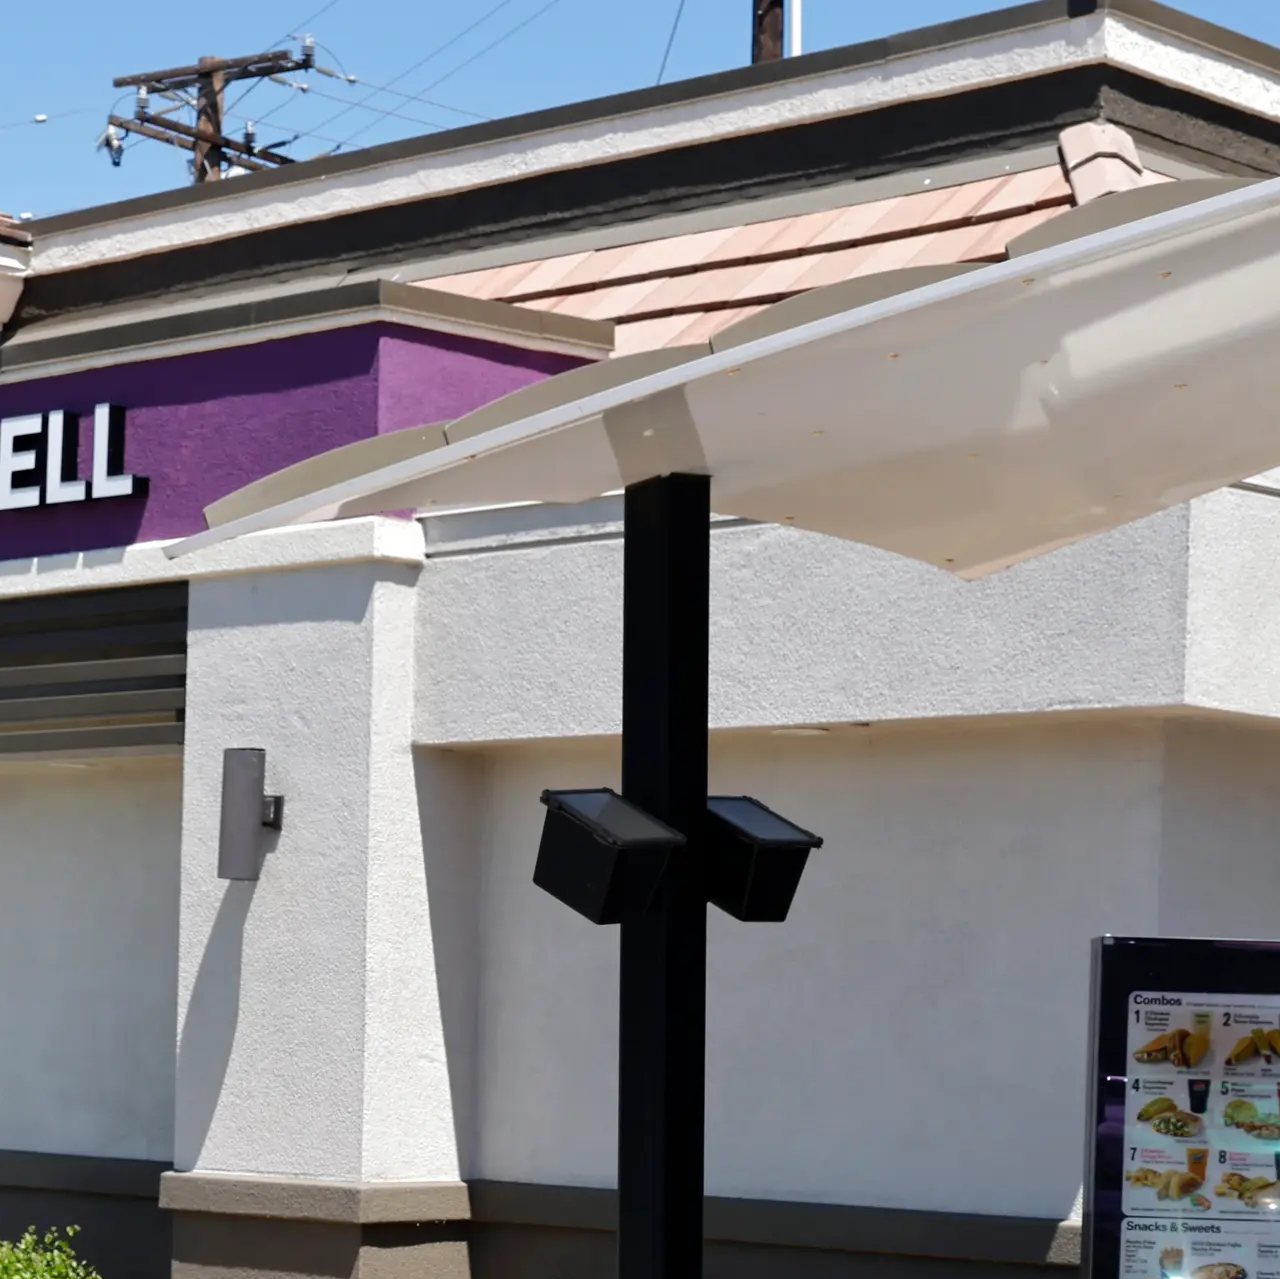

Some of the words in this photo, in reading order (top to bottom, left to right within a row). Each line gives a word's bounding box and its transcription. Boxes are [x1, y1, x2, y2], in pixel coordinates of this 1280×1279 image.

[1133, 994, 1182, 1006] Combos
[1134, 1009, 1140, 1023] 1
[1222, 1012, 1231, 1027] 2
[1132, 1078, 1140, 1091] 4
[1220, 1081, 1229, 1095] 5
[1130, 1147, 1137, 1161] 7
[1218, 1150, 1227, 1164] 8
[1126, 1221, 1168, 1232] Snacks
[1170, 1223, 1178, 1232] &
[1181, 1222, 1222, 1234] Sweets
